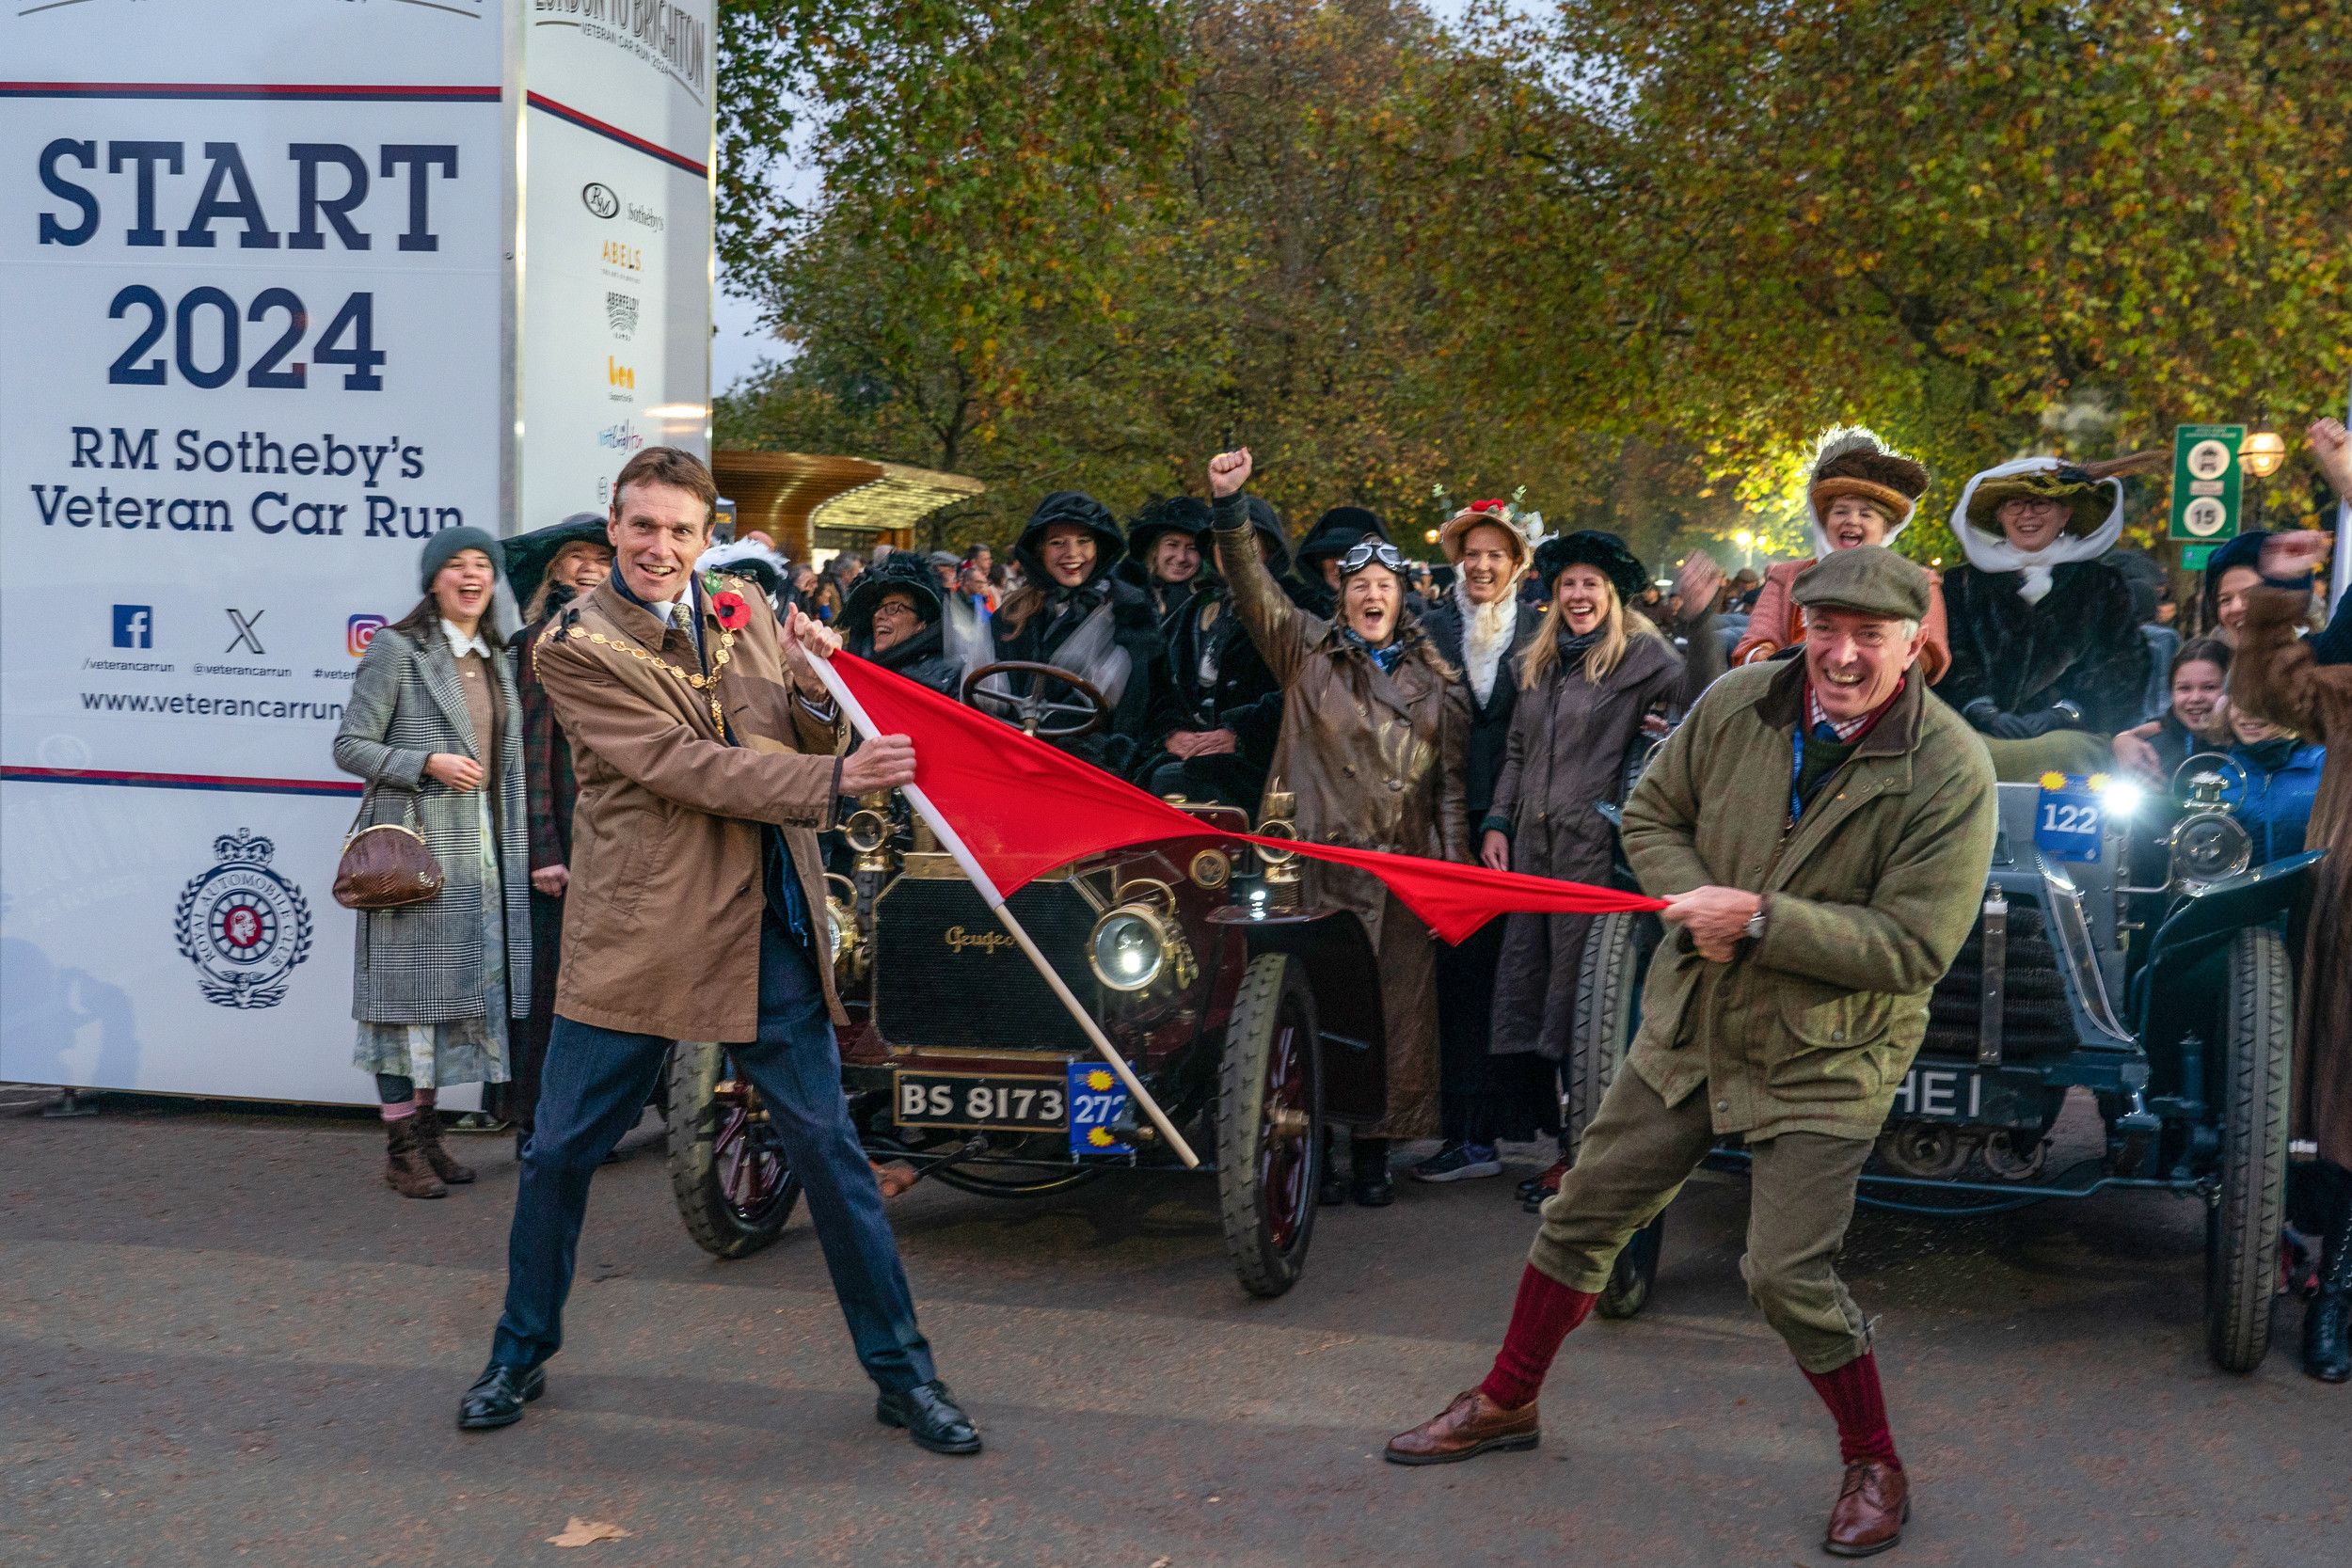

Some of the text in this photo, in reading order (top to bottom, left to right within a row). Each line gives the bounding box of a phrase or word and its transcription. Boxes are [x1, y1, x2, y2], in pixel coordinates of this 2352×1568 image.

[580, 22, 616, 44] VETERAN
[39, 137, 459, 251] START
[602, 240, 643, 271] ABELS
[108, 284, 388, 391] 2024
[71, 426, 425, 488] RM Sotheby's
[31, 484, 465, 540] Veteran Car Run
[2194, 509, 2217, 526] 15
[82, 657, 175, 673] /veterancarrun
[193, 662, 293, 678] @veterancarrun
[2042, 802, 2099, 835] 122
[201, 873, 294, 920] AUTOMOBILE
[900, 1084, 1065, 1120] BS 8173
